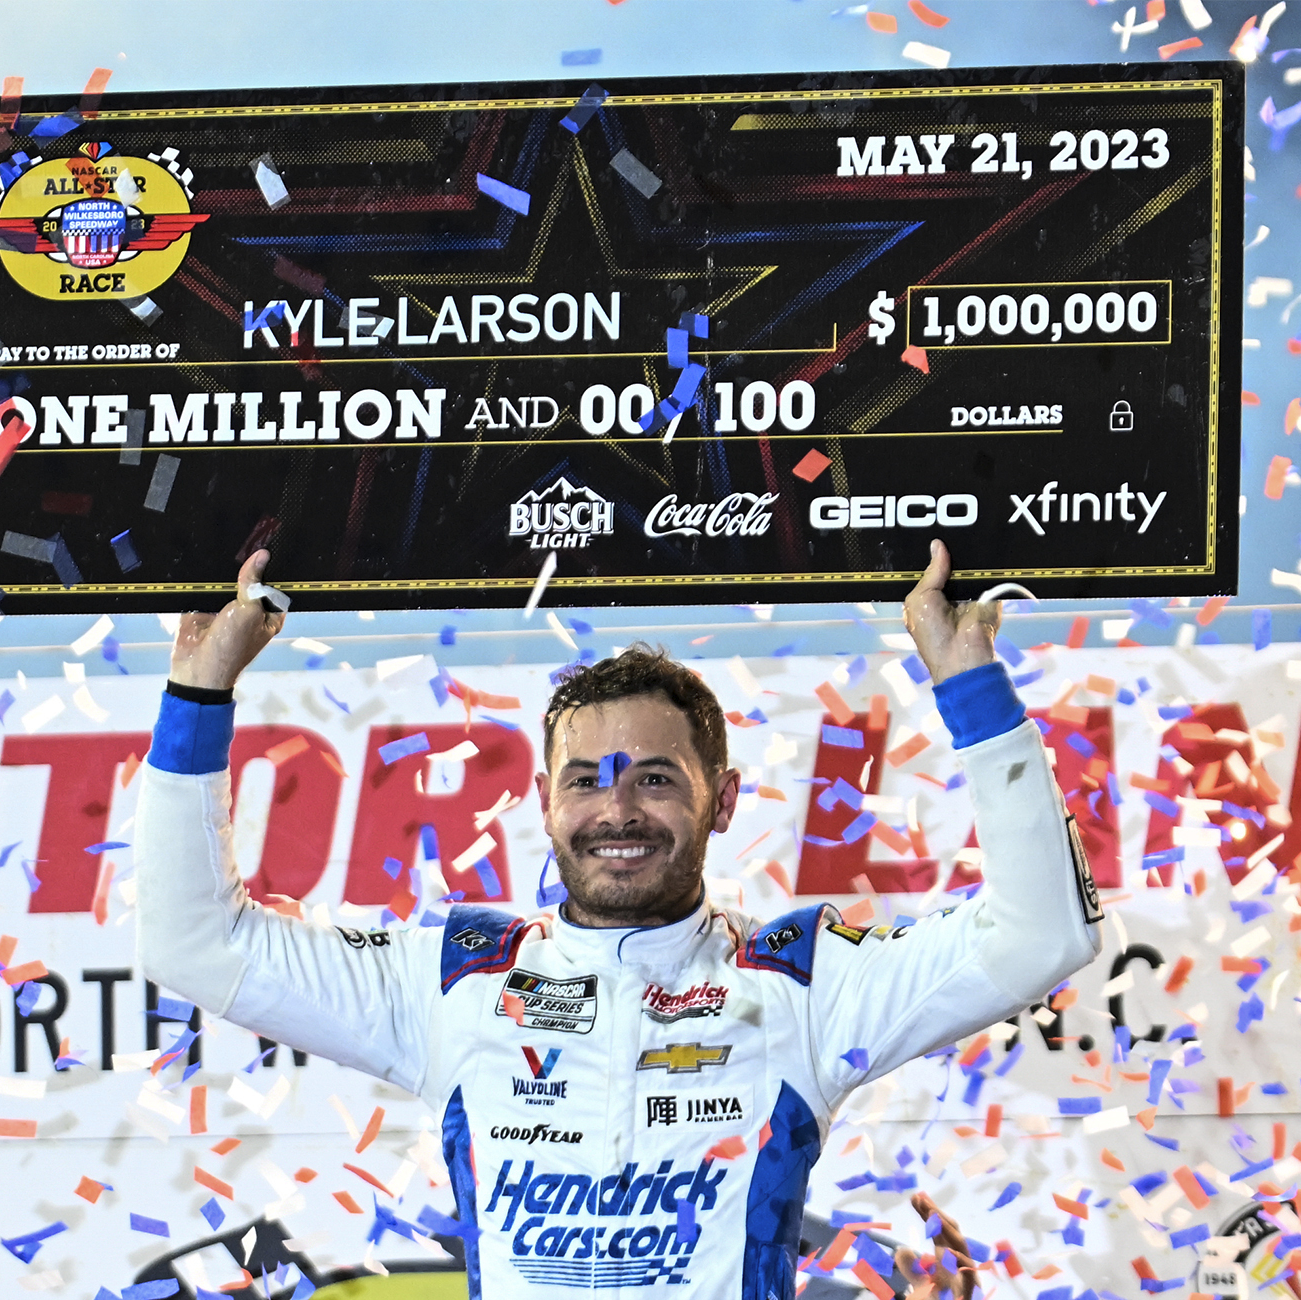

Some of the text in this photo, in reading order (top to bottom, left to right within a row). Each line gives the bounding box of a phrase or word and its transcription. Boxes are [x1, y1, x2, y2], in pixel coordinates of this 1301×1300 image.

[836, 128, 1171, 179] MAY 21, 2023
[71, 166, 118, 176] NASCAR
[92, 176, 147, 195] STR
[64, 210, 124, 221] WILKESBORO
[78, 202, 111, 211] NORTH
[42, 221, 57, 232] 20
[68, 219, 119, 230] SPEEDWAY
[85, 258, 101, 266] USA
[59, 273, 126, 293] RACE
[243, 292, 621, 348] KYLE LARSON
[868, 290, 1158, 345] $ 1,000,000
[26, 346, 48, 360] TO
[53, 345, 88, 360] THE
[92, 344, 149, 359] ORDER
[152, 343, 180, 358] OF
[149, 388, 446, 444] MILLION
[465, 395, 559, 430] AND
[950, 404, 1063, 427] DOLLARS
[509, 498, 614, 537] BUSCH
[644, 481, 1167, 538] Coca-Cola GEICO xfinity
[533, 532, 589, 549] LIGHT
[538, 981, 586, 997] NASCAR
[642, 981, 729, 1007] Hendrick
[541, 1000, 584, 1014] SERIES
[531, 1018, 579, 1029] CHAMPION
[512, 1075, 567, 1099] VALVOLINE
[524, 1098, 555, 1106] TRUSTED
[686, 1097, 742, 1122] JINYA
[490, 1124, 583, 1145] GOODYEAR
[485, 1159, 728, 1231] Hendrick
[511, 1217, 701, 1259] Cars.com
